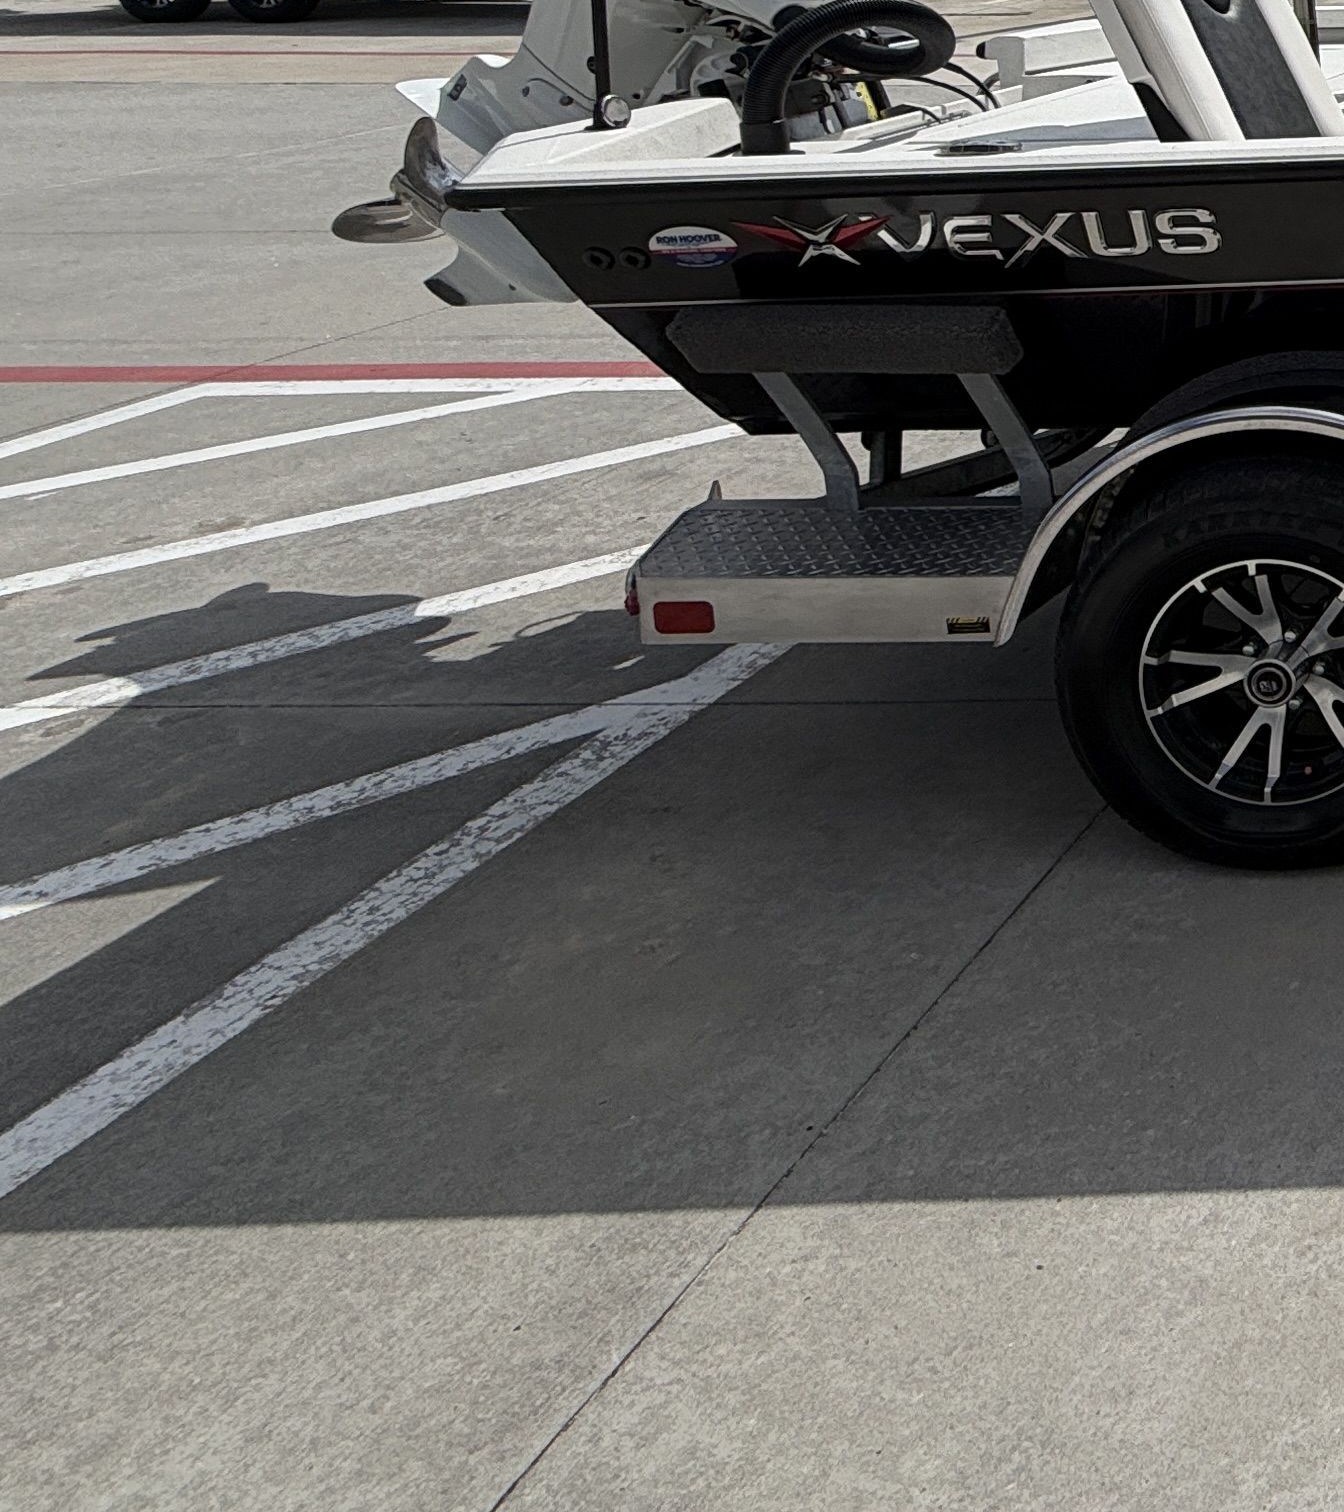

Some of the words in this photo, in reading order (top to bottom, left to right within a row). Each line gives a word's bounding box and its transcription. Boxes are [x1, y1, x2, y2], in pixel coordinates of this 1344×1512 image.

[656, 235, 678, 244] RON
[678, 233, 721, 243] HOOVER
[857, 207, 1224, 268] VEXUS
